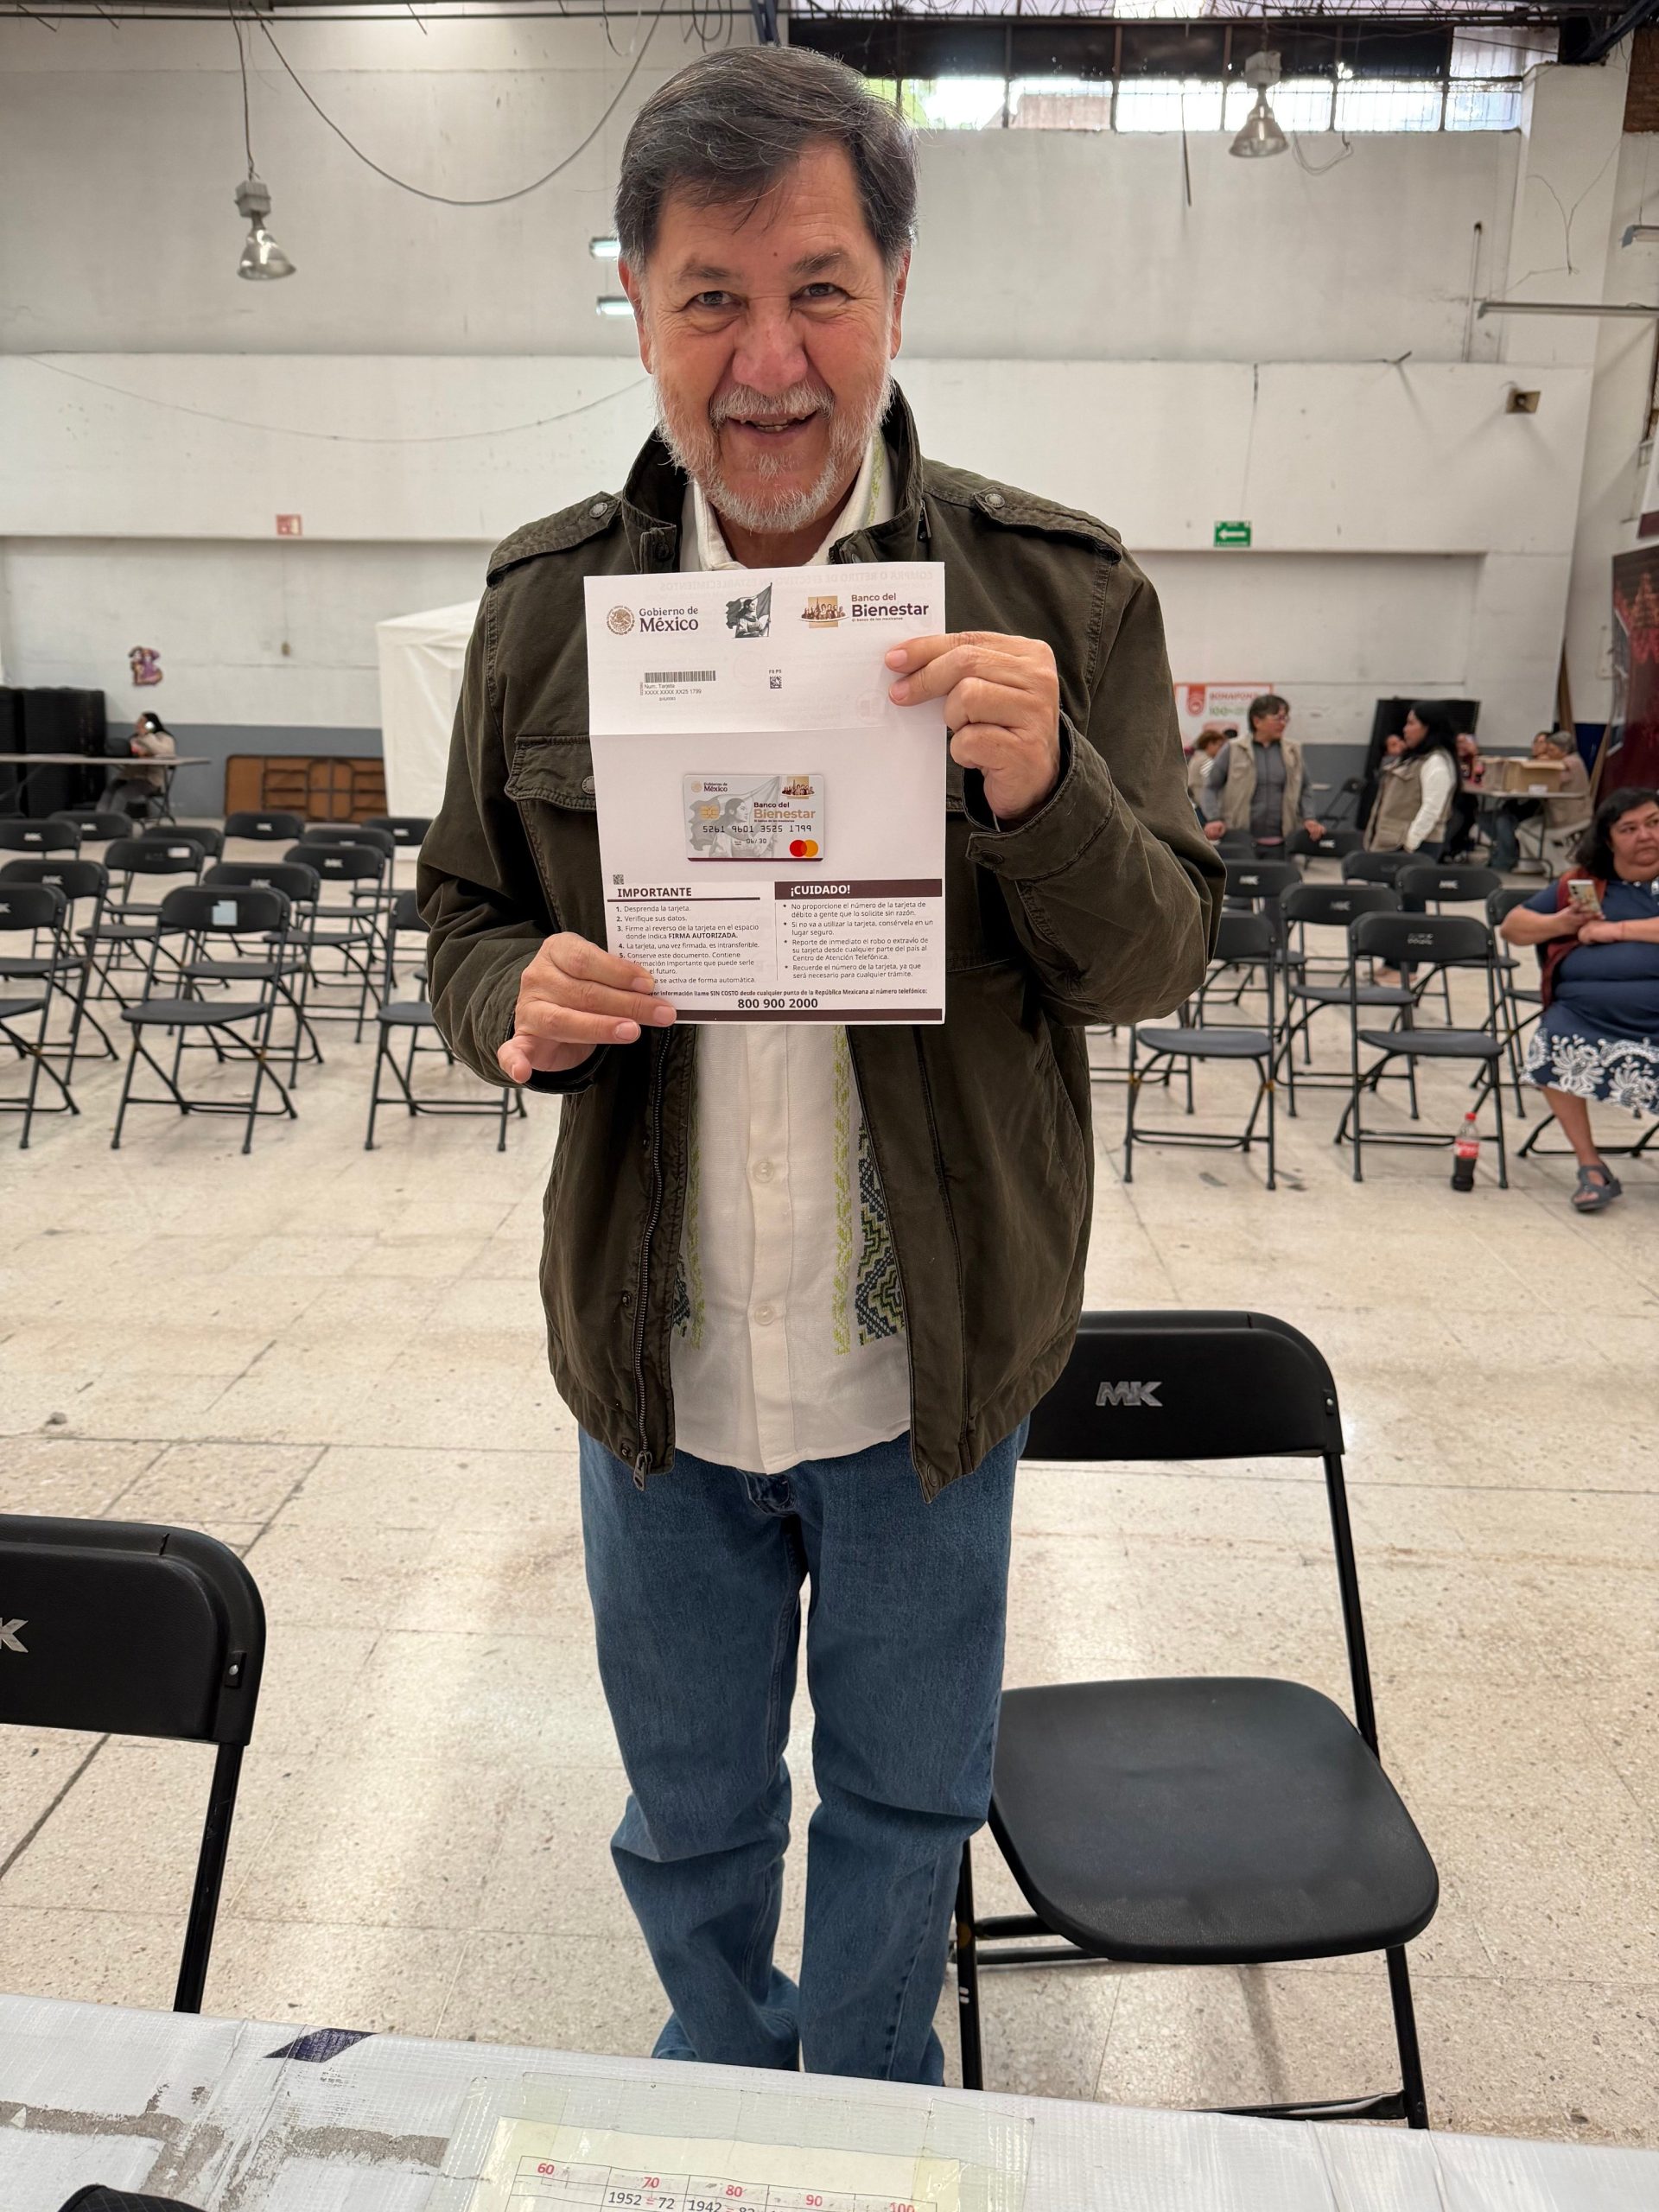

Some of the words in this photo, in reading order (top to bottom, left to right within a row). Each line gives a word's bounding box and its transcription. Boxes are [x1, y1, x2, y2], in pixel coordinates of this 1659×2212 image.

[639, 608, 685, 616] Gobierno
[852, 603, 929, 617] Bienestar
[640, 617, 698, 632] México
[754, 809, 816, 819] Bienestar
[618, 888, 692, 897] IMPORTANTE
[791, 885, 850, 896] ¡CUIDADO!
[738, 999, 759, 1008] 800
[763, 999, 785, 1008] 900
[789, 998, 818, 1008] 2000
[1096, 1381, 1163, 1407] MK
[537, 2163, 554, 2175] 60
[642, 2177, 660, 2188] 70
[725, 2184, 743, 2197] 80
[608, 2192, 642, 2205] 1952
[658, 2197, 675, 2209] 72
[689, 2199, 722, 2212] 1942
[805, 2194, 823, 2207] 90
[889, 2202, 915, 2212] 100
